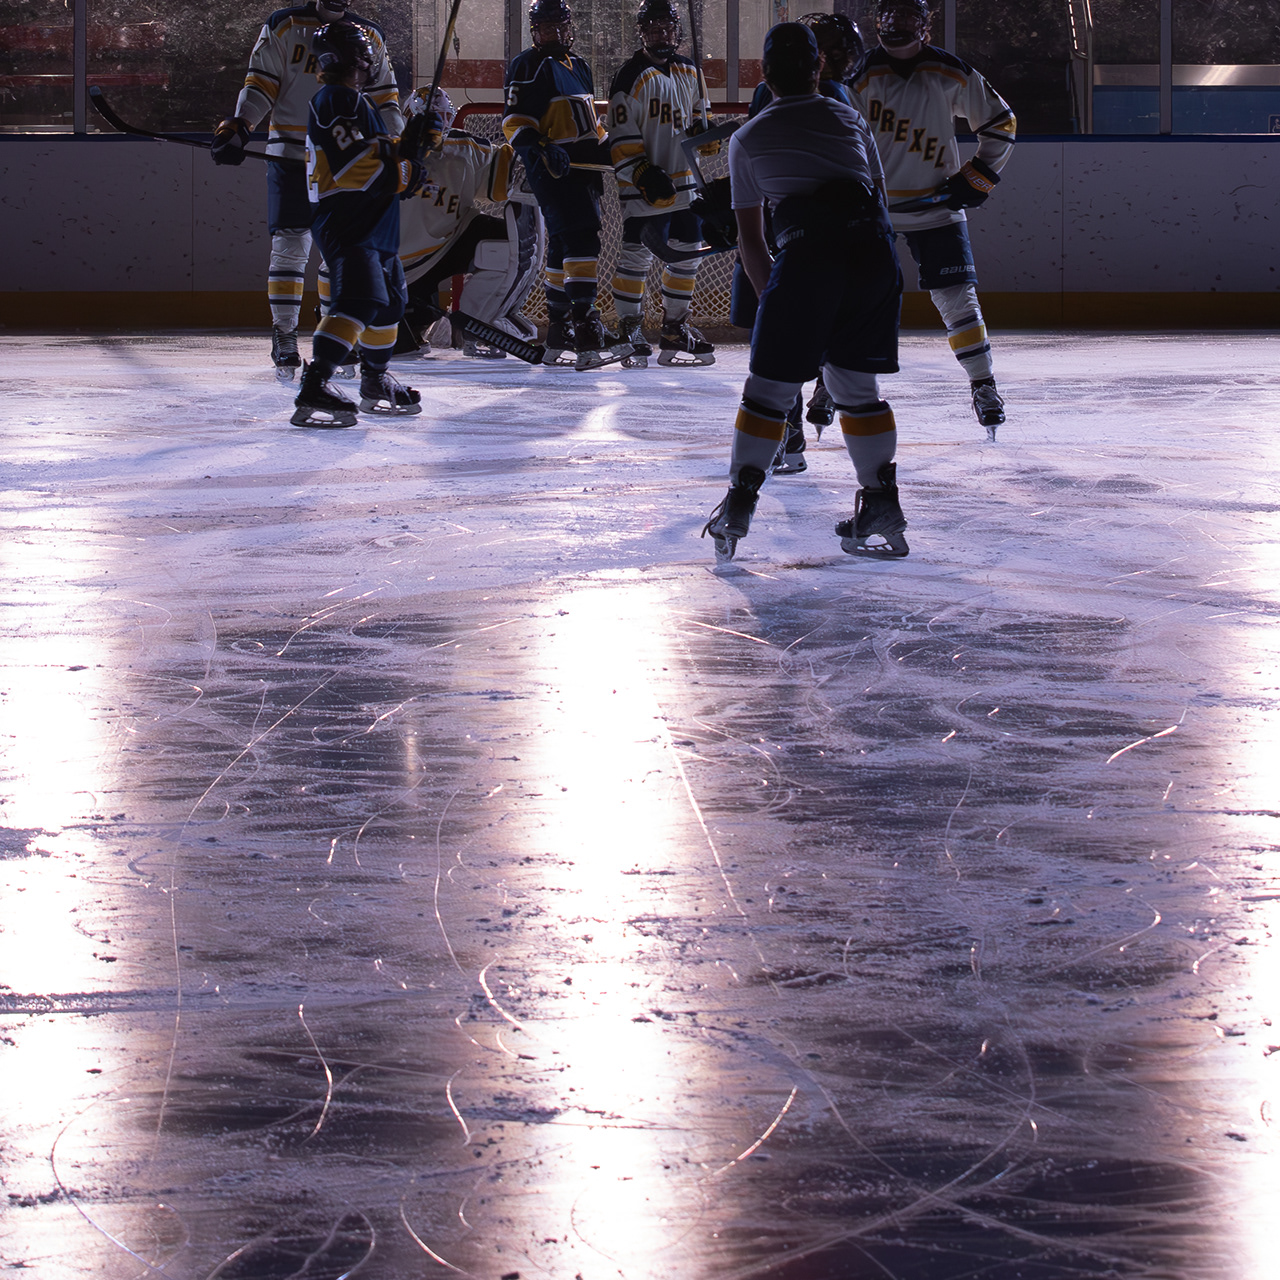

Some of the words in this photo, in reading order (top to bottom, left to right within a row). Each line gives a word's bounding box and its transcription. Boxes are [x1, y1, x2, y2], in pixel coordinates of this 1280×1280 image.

[611, 105, 626, 128] 18
[649, 98, 683, 132] DRE
[870, 100, 945, 168] DREXEL
[464, 320, 539, 361] WARRIOR
